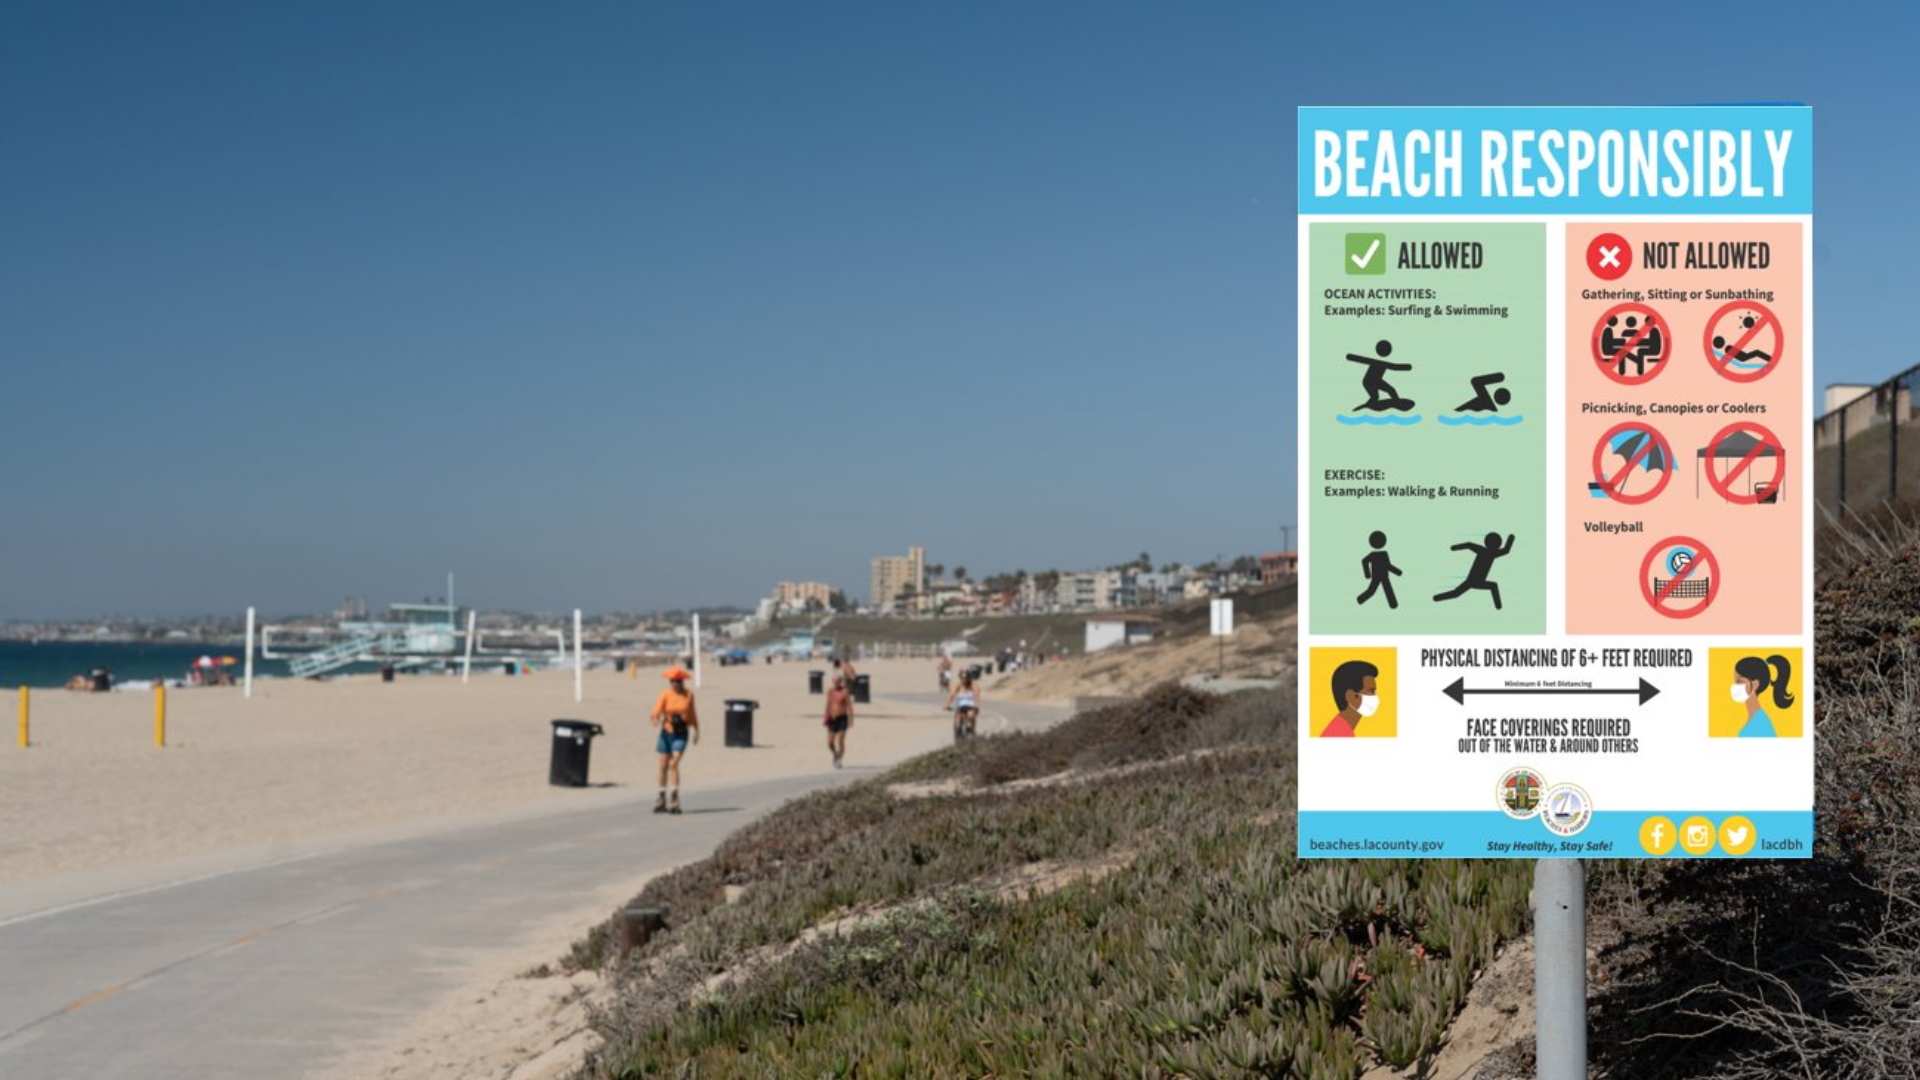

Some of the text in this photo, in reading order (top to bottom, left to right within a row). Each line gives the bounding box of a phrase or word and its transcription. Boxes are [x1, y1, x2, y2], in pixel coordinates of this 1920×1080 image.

[1314, 129, 1793, 198] BEACH RESPONSIBLY
[1397, 241, 1484, 270] ALLOWED
[1643, 241, 1771, 270] NOT ALLOWED
[1324, 288, 1437, 300] OCEAN ACTIVITIES:
[1582, 288, 1775, 302] Gathering, Sitting or Sunbathing
[1324, 304, 1509, 319] Examples: Surfing & Swimming
[1582, 402, 1767, 417] Picnicking, Canopies or Coolers
[1324, 469, 1385, 481] EXERCISE:
[1324, 485, 1500, 500] Examples: Walking & Running
[1584, 520, 1644, 535] Volleyball
[1421, 648, 1693, 669] PHYSICAL DISTANCING OF 6+ FEET REQUIRED
[1504, 680, 1536, 688] Minimum
[1543, 680, 1556, 688] feet
[1466, 718, 1631, 738] FACE COVERINGS REQUIRED
[1458, 739, 1639, 754] OUT OF THE WATER & AROUND OTHERS
[1309, 838, 1444, 854] beaches.lacounty.gov
[1487, 840, 1613, 854] Stay Healthy, Stay Safe!
[1761, 838, 1803, 851] lacdbh
